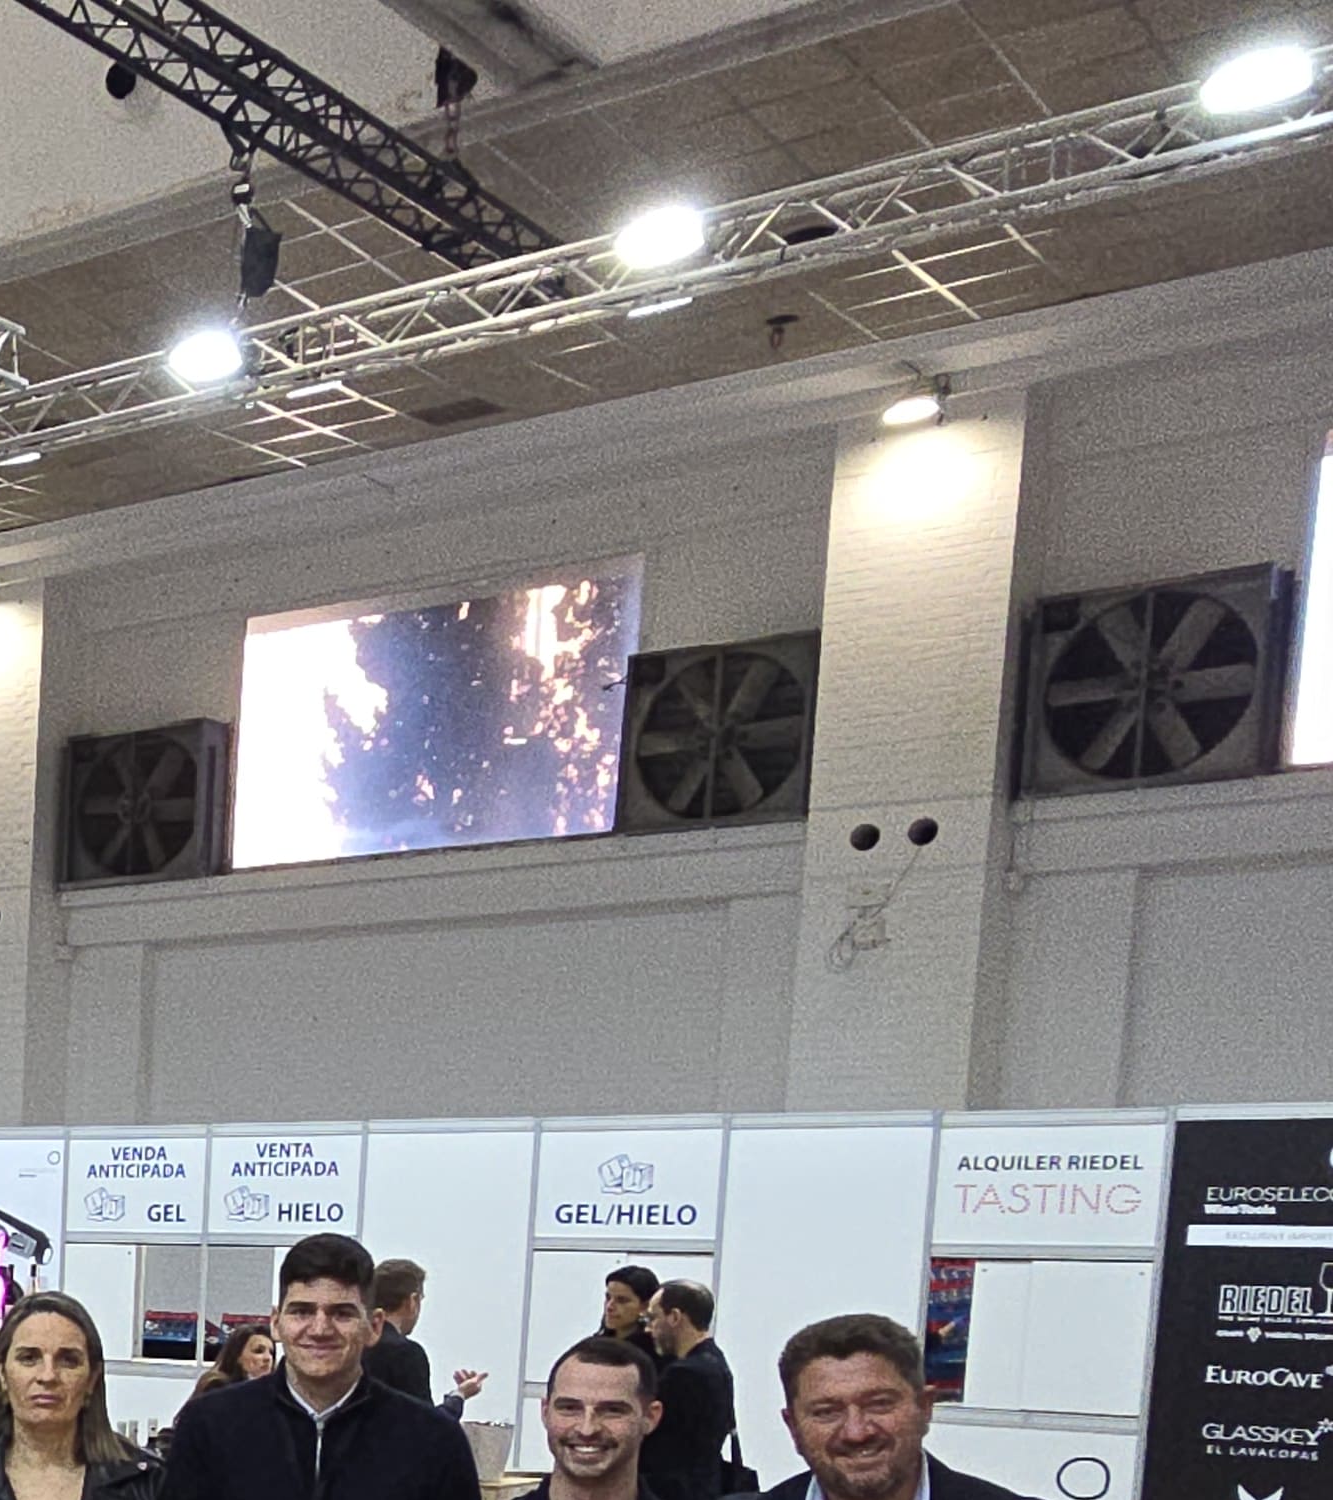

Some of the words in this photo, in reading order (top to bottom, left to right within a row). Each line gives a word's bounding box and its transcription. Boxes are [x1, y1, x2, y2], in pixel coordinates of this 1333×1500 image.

[111, 1146, 167, 1161] VENDA
[256, 1142, 313, 1158] VENTA
[87, 1163, 186, 1179] ANTICIPADA
[232, 1161, 339, 1177] ANTICIPADA
[957, 1155, 1062, 1172] ALQUILER
[1067, 1154, 1144, 1171] RIEDEL
[953, 1183, 1142, 1215] TASTING
[147, 1203, 186, 1222] GEL
[277, 1203, 344, 1222] HIELO
[555, 1203, 697, 1226] GEL/HIELO
[1218, 1284, 1313, 1317] RIEDEL
[1201, 1422, 1320, 1446] GLASSKEY
[1206, 1445, 1222, 1455] EL
[1229, 1446, 1319, 1461] LAVACOPAS
